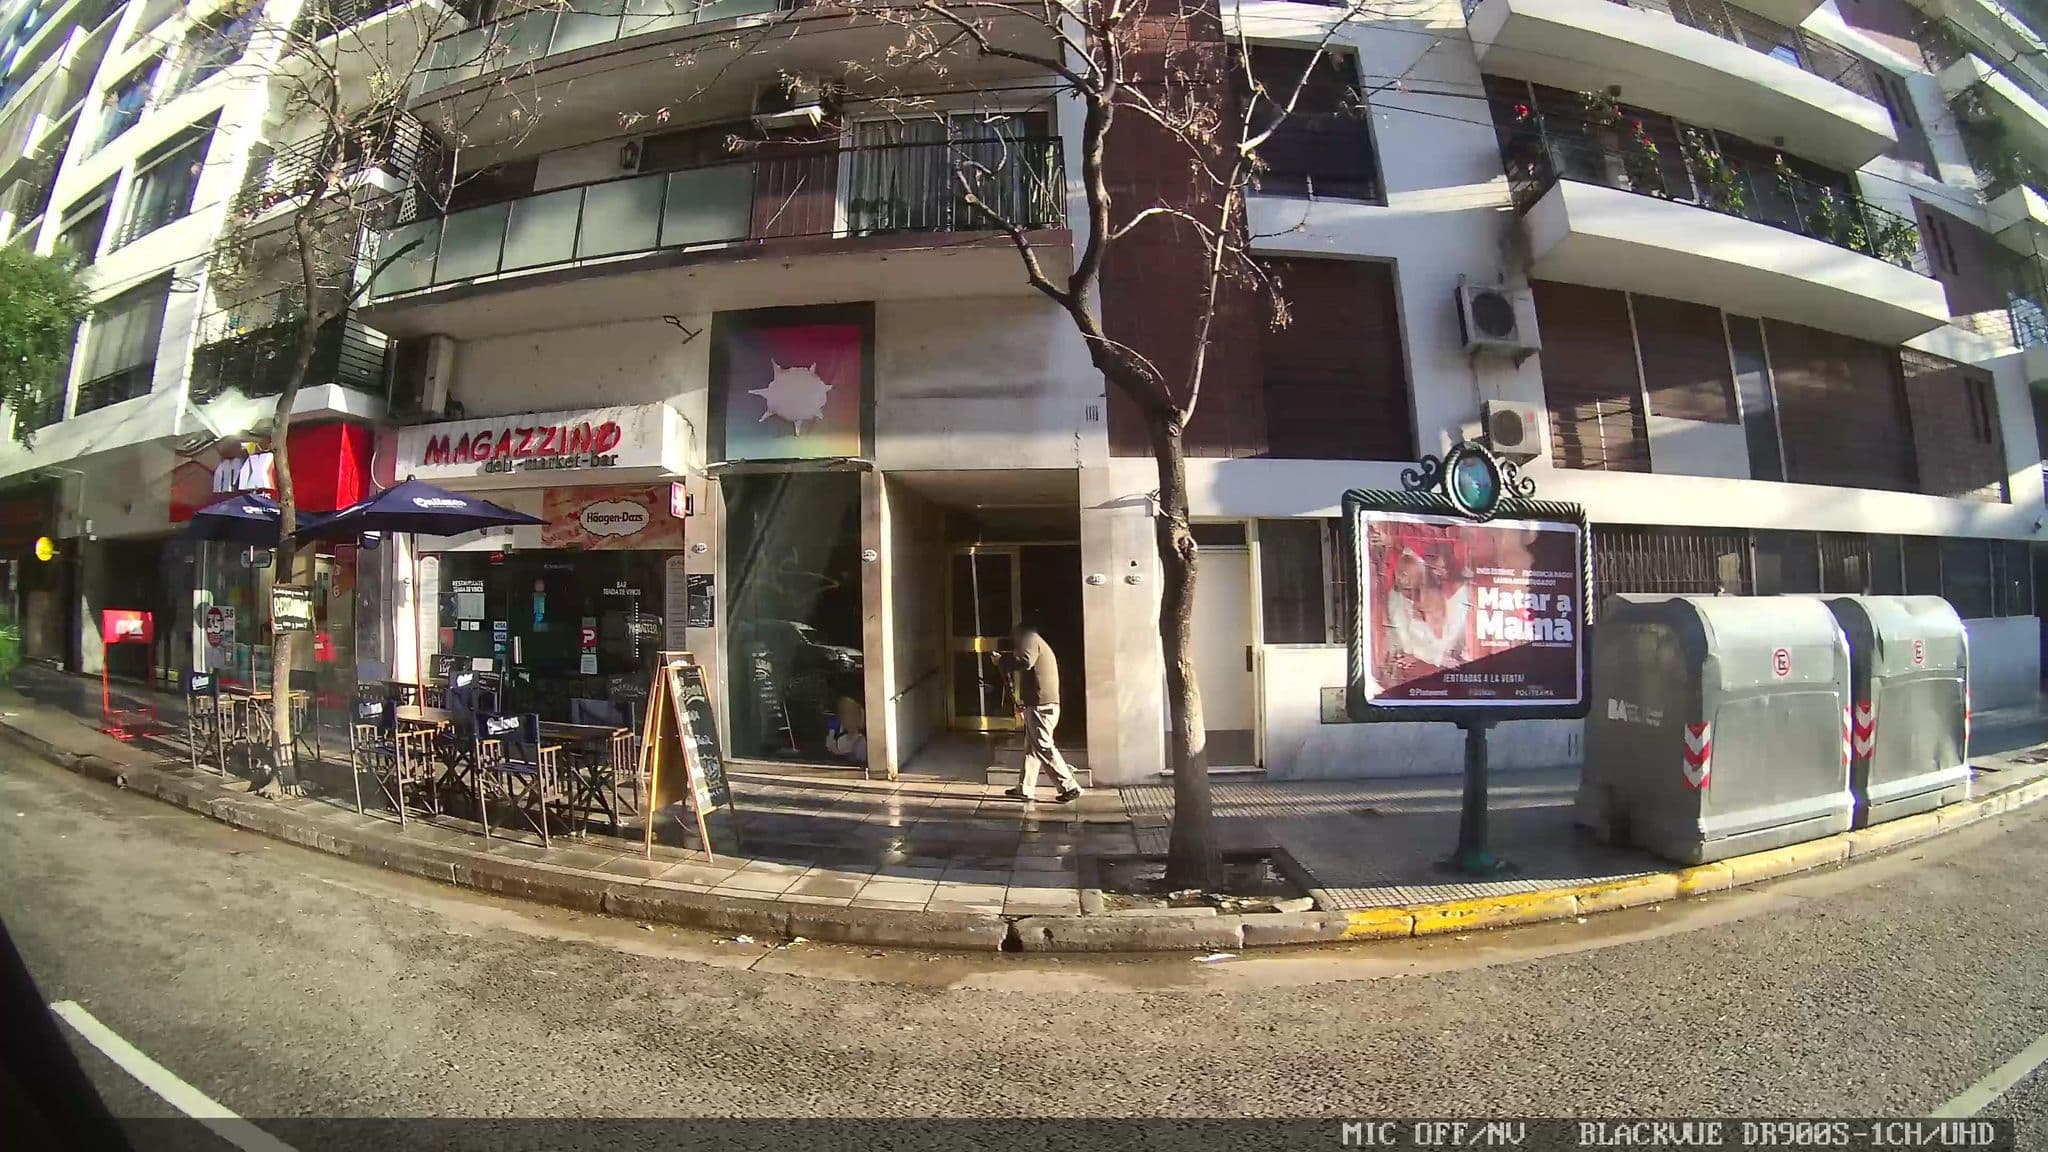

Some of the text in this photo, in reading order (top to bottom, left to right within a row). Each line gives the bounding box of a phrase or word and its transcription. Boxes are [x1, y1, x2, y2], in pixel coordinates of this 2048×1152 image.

[423, 420, 622, 466] MAGAZZINO
[586, 511, 644, 524] Häagen-Dazs
[1477, 586, 1572, 612] Matar a
[1476, 609, 1574, 641] Mamá
[1490, 673, 1500, 683] LA
